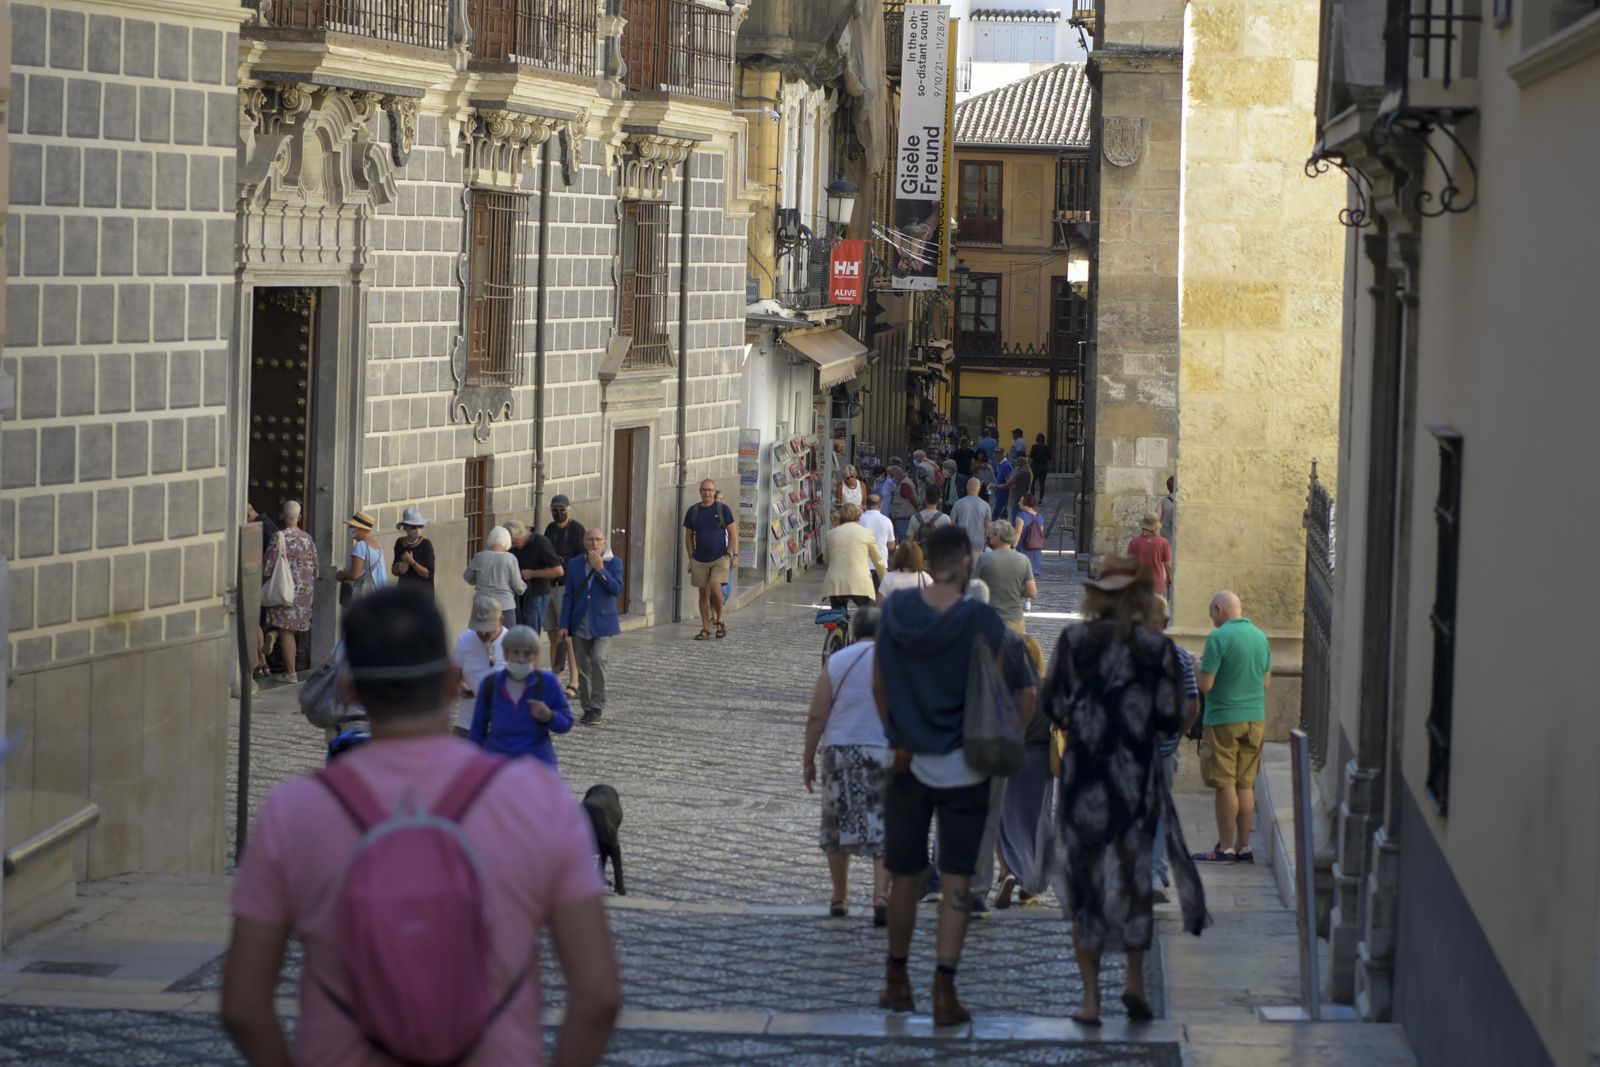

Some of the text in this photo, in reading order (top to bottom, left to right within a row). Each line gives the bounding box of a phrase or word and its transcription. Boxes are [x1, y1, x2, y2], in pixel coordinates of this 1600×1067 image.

[907, 10, 918, 62] In the oh-
[917, 10, 929, 96] so-distant south
[935, 10, 946, 50] 11/28/21
[933, 60, 943, 98] 9/10/21
[900, 134, 920, 195] Gisèle
[919, 126, 940, 195] Freund
[834, 260, 859, 276] HH
[834, 288, 857, 297] ALIVE
